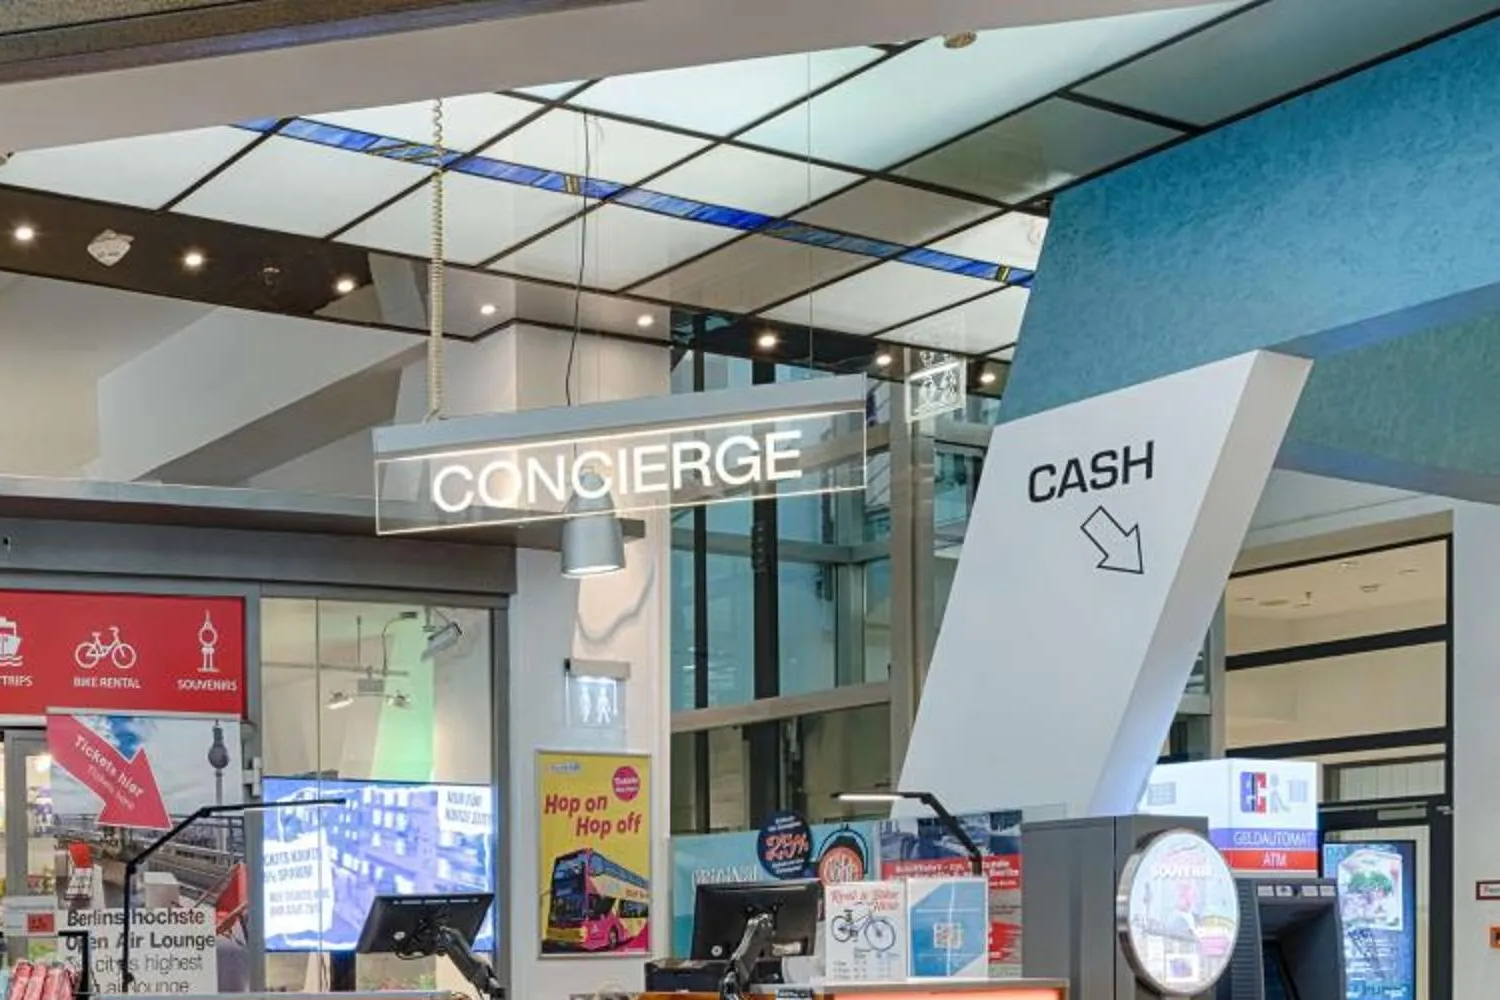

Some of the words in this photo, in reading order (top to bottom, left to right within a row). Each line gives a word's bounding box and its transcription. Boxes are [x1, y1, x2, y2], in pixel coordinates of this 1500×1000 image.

[432, 430, 802, 513] CONCIERGE
[1028, 440, 1154, 503] CASH
[74, 676, 97, 687] BIKE
[100, 676, 141, 689] RENTAL
[177, 679, 237, 691] SOUVENIRS
[74, 735, 117, 778] Tickets
[543, 794, 581, 818] Hop
[585, 795, 609, 811] on
[575, 816, 612, 840] Hop
[617, 811, 643, 834] off
[1233, 831, 1314, 847] GELDAUTOMAT
[1262, 852, 1287, 867] ATM
[67, 909, 124, 927] Berlins
[150, 931, 216, 951] Lounge
[145, 954, 204, 975] highest
